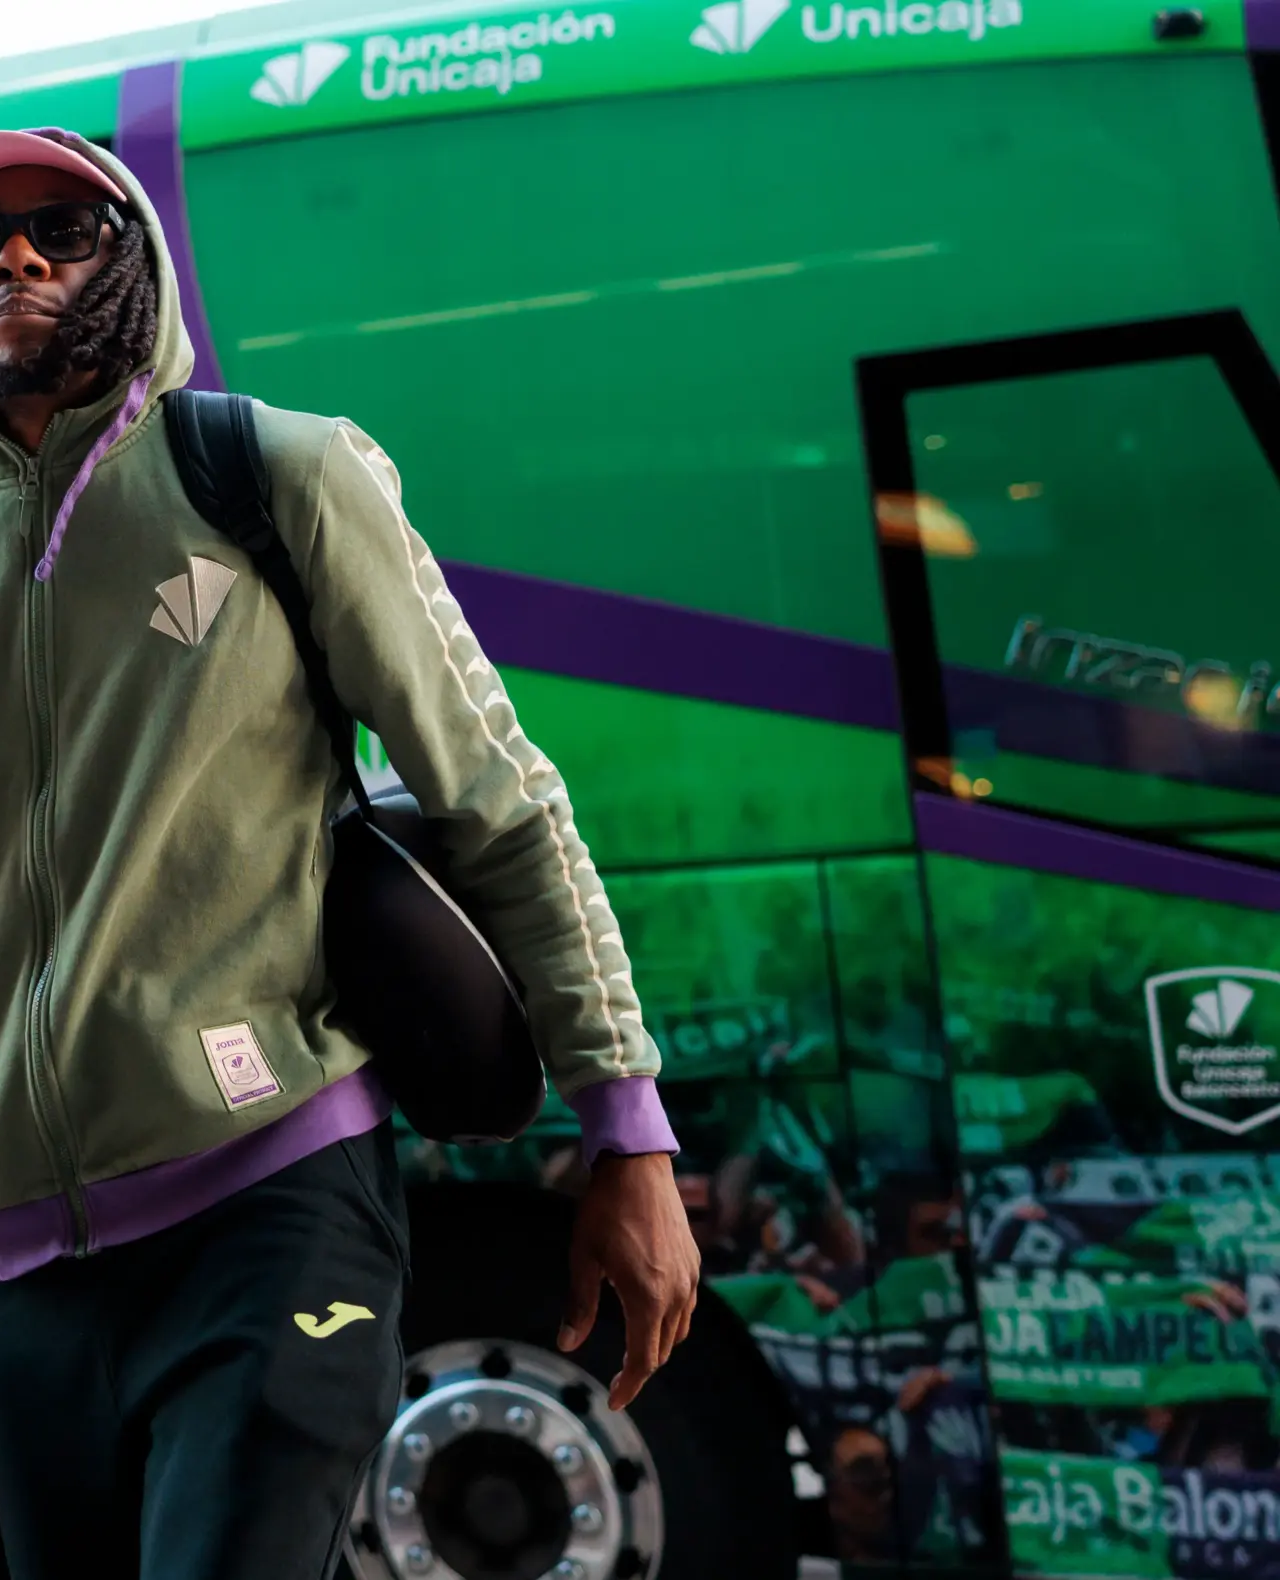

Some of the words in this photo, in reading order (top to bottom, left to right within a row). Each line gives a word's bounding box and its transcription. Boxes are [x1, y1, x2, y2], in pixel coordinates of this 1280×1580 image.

[362, 10, 615, 65] Fundación
[801, 0, 1023, 42] Unicaja
[361, 51, 543, 100] Unicaja
